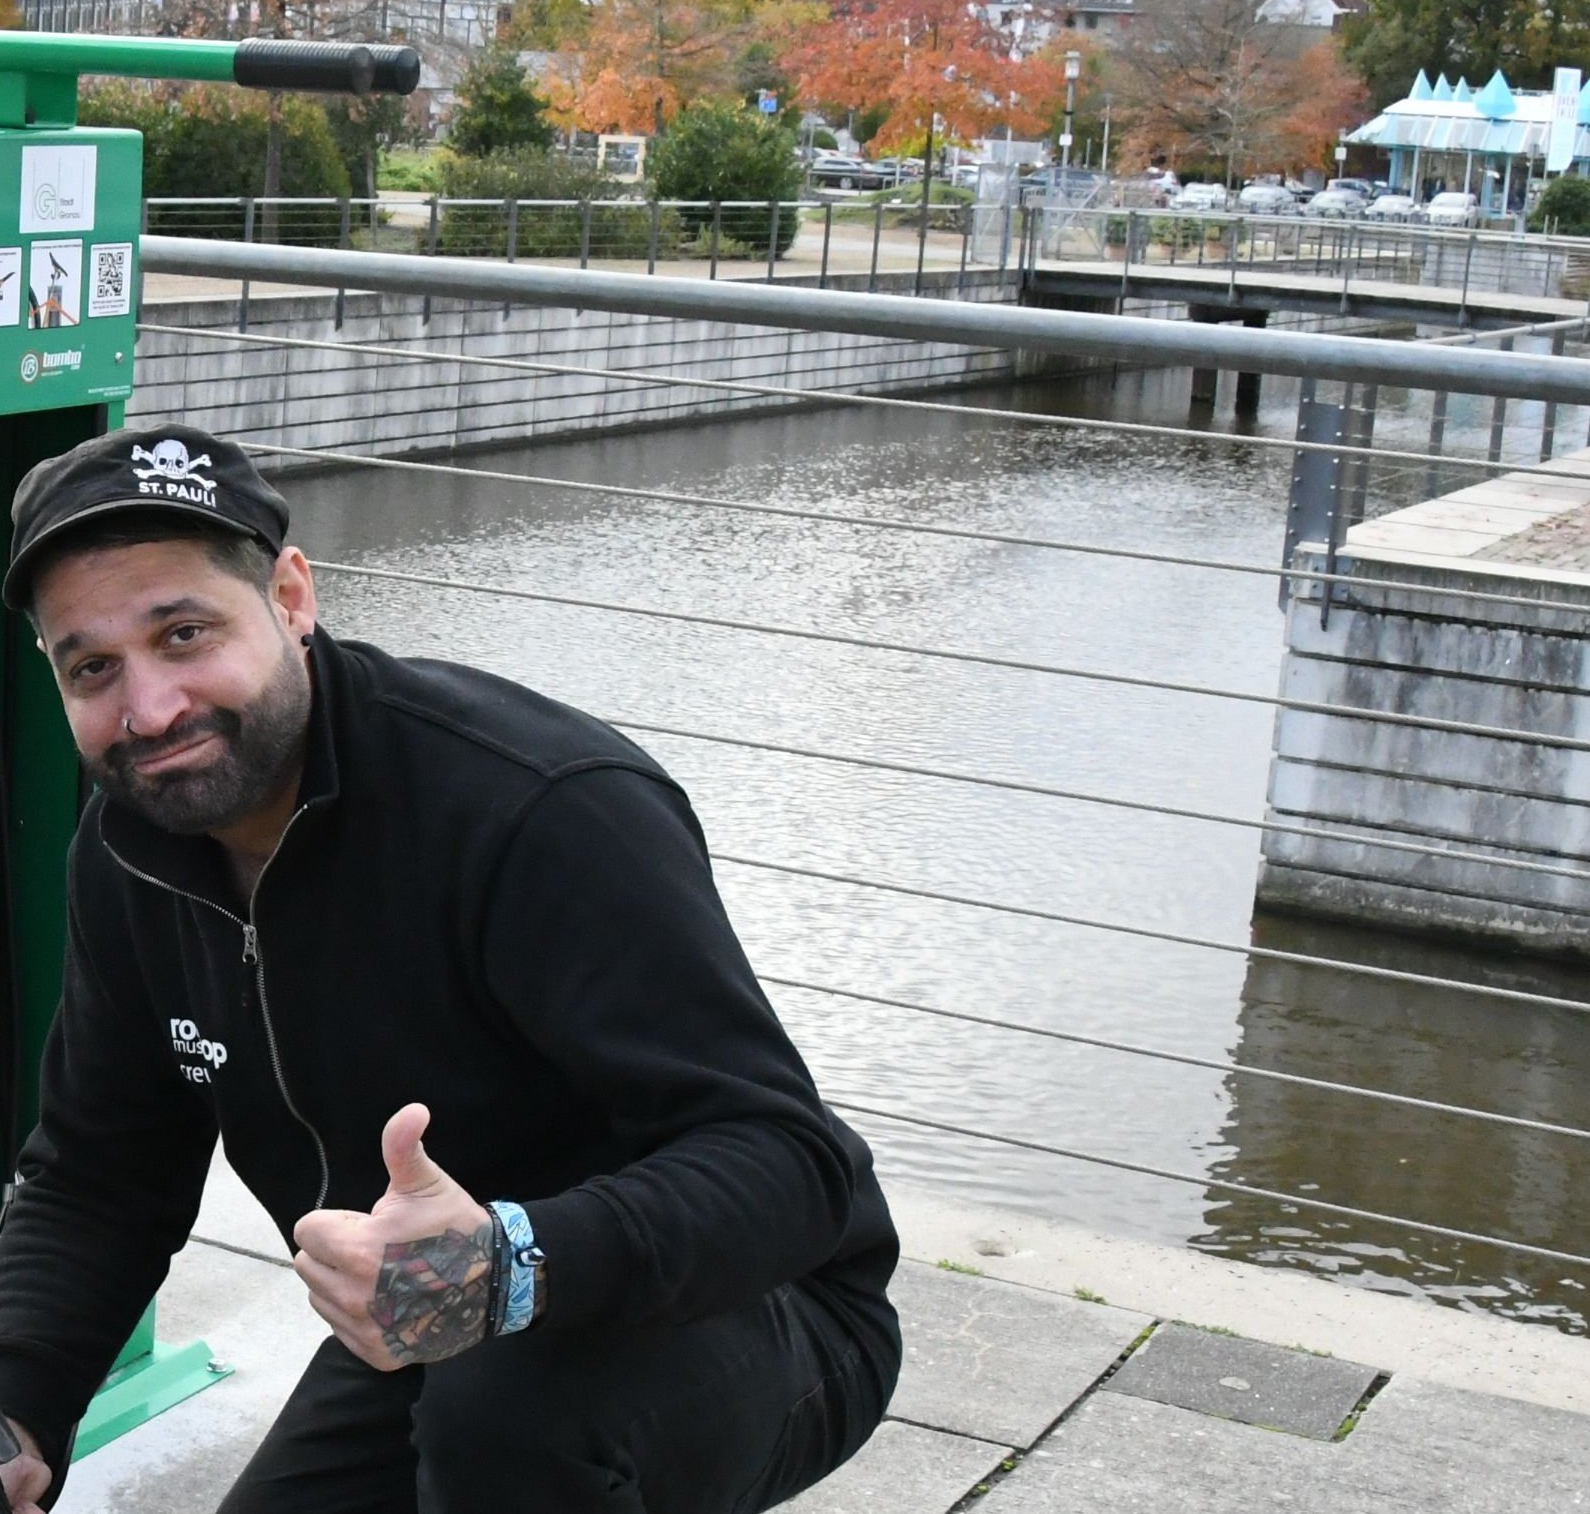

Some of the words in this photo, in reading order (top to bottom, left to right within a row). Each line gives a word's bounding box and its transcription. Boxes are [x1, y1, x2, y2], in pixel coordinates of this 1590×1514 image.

[138, 481, 164, 494] ST.
[166, 483, 217, 508] PAULI
[170, 1018, 200, 1041] ro
